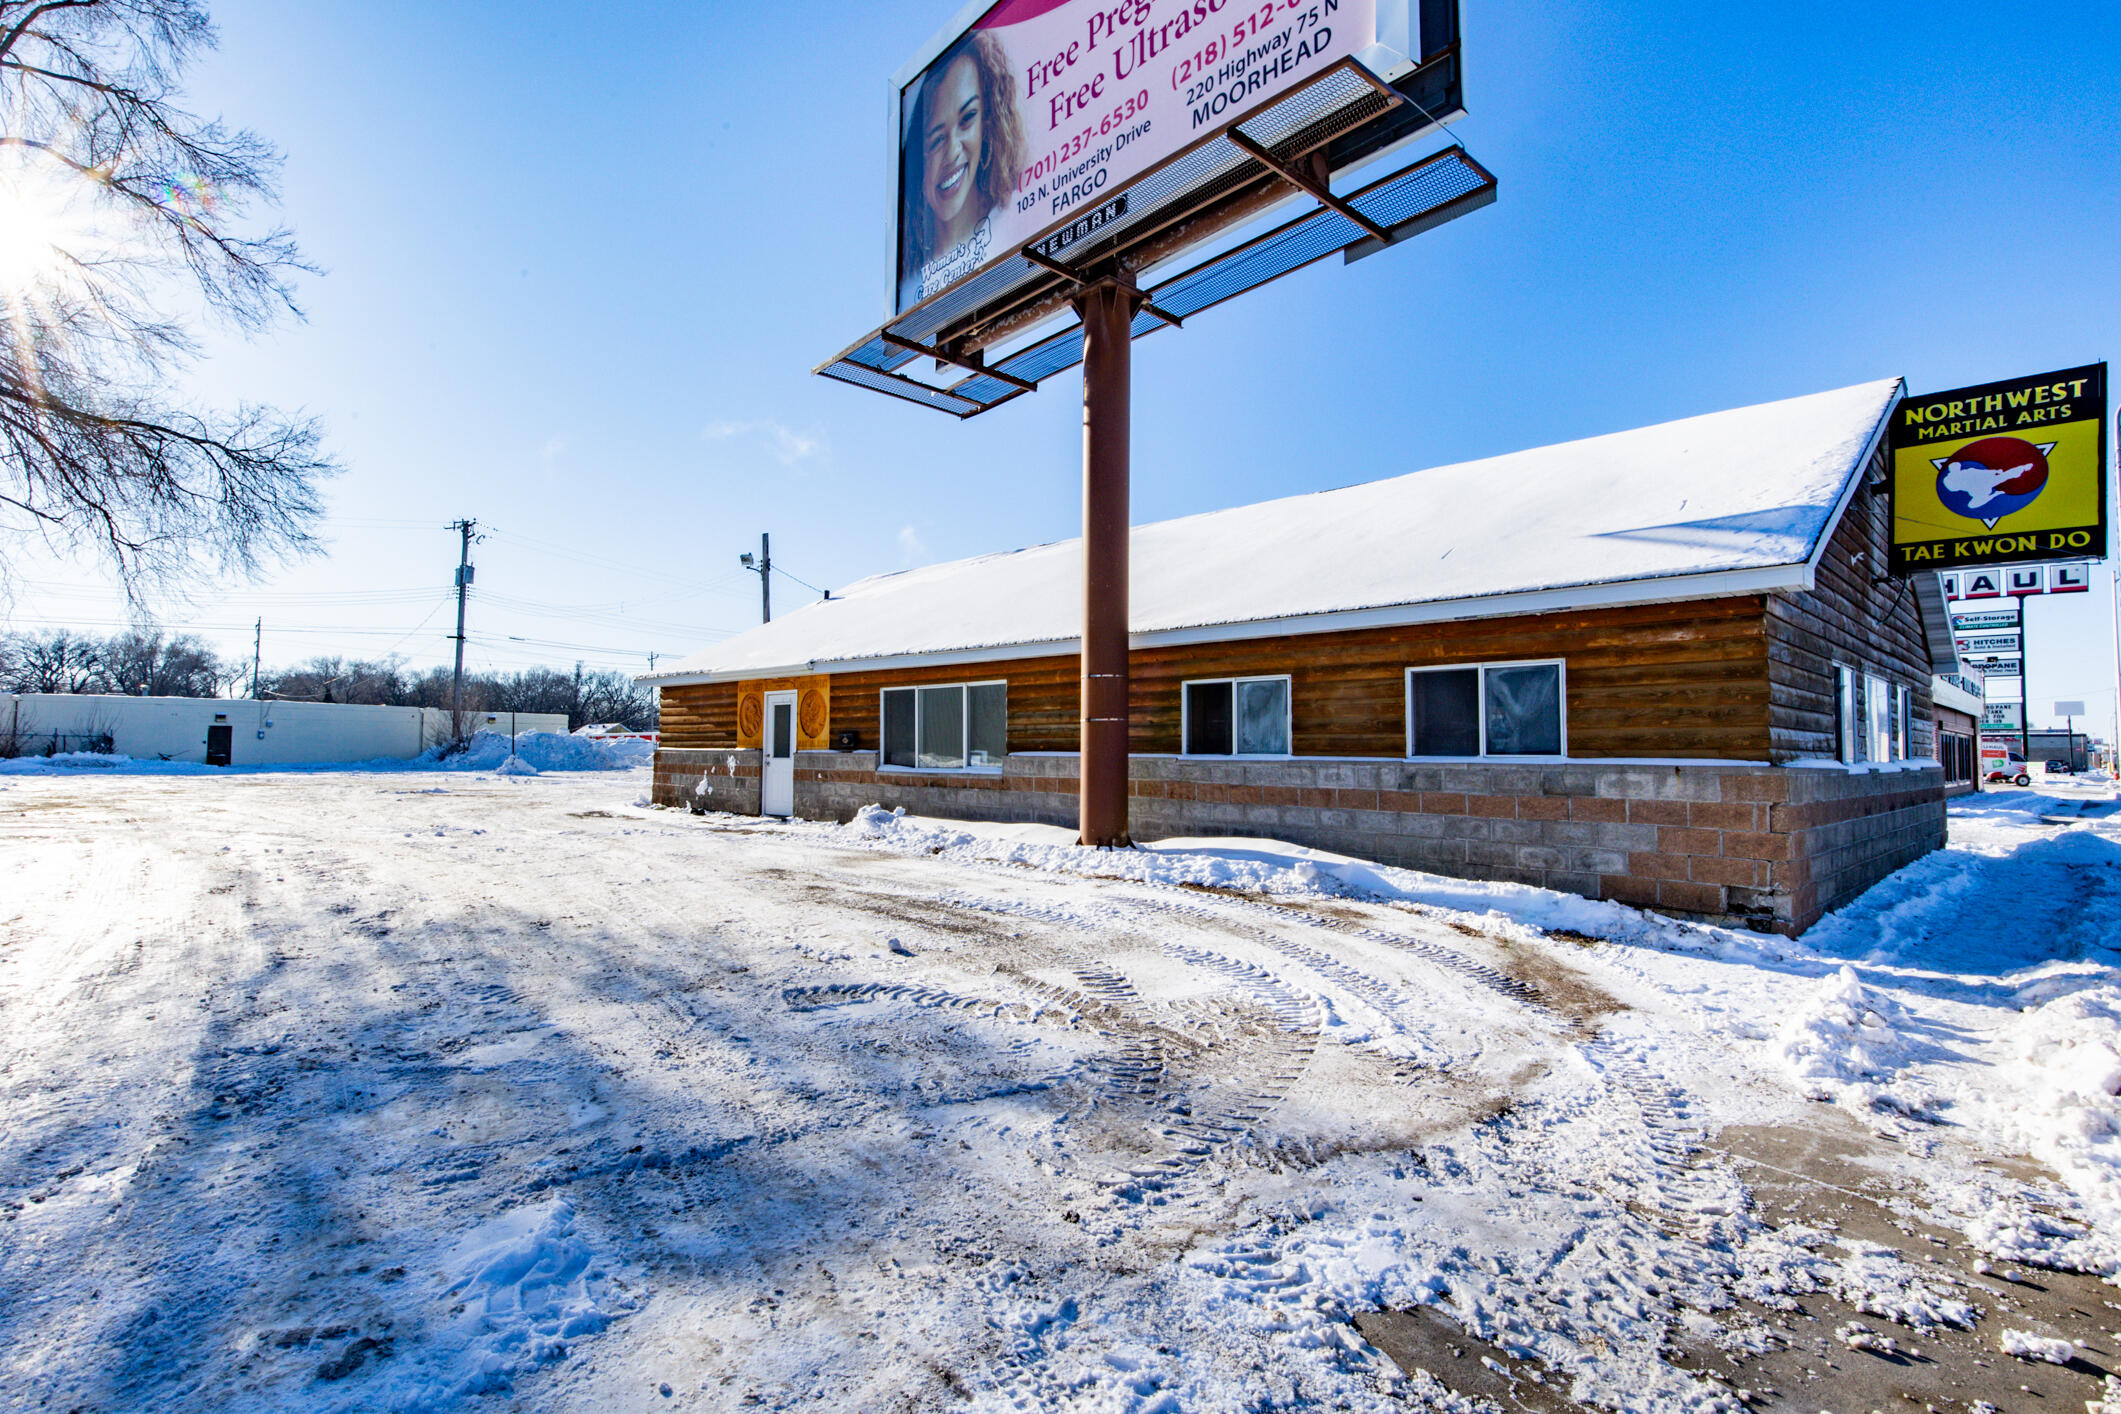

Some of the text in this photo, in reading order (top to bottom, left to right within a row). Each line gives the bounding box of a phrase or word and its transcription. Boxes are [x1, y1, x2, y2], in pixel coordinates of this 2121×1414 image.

[1026, 40, 1079, 99] Free
[1172, 34, 1227, 91] (218)
[1186, 0, 1338, 106] 220 Highway 75 N
[1193, 27, 1332, 130] MOORHEAD
[1049, 72, 1104, 131] Free
[1017, 120, 1151, 214] 103 N. University Drive
[1018, 89, 1149, 193] (701) 237-6530
[1052, 168, 1107, 216] FARGO
[1036, 202, 1117, 256] NEWMAN
[914, 256, 978, 305] Care Center
[920, 242, 966, 284] Women's
[1905, 378, 2089, 426] NORTHWEST
[1918, 404, 2072, 440] MARTIAL ARTS
[1901, 530, 2091, 562] TAE KWON DO
[1964, 614, 2016, 622] Self-Storage
